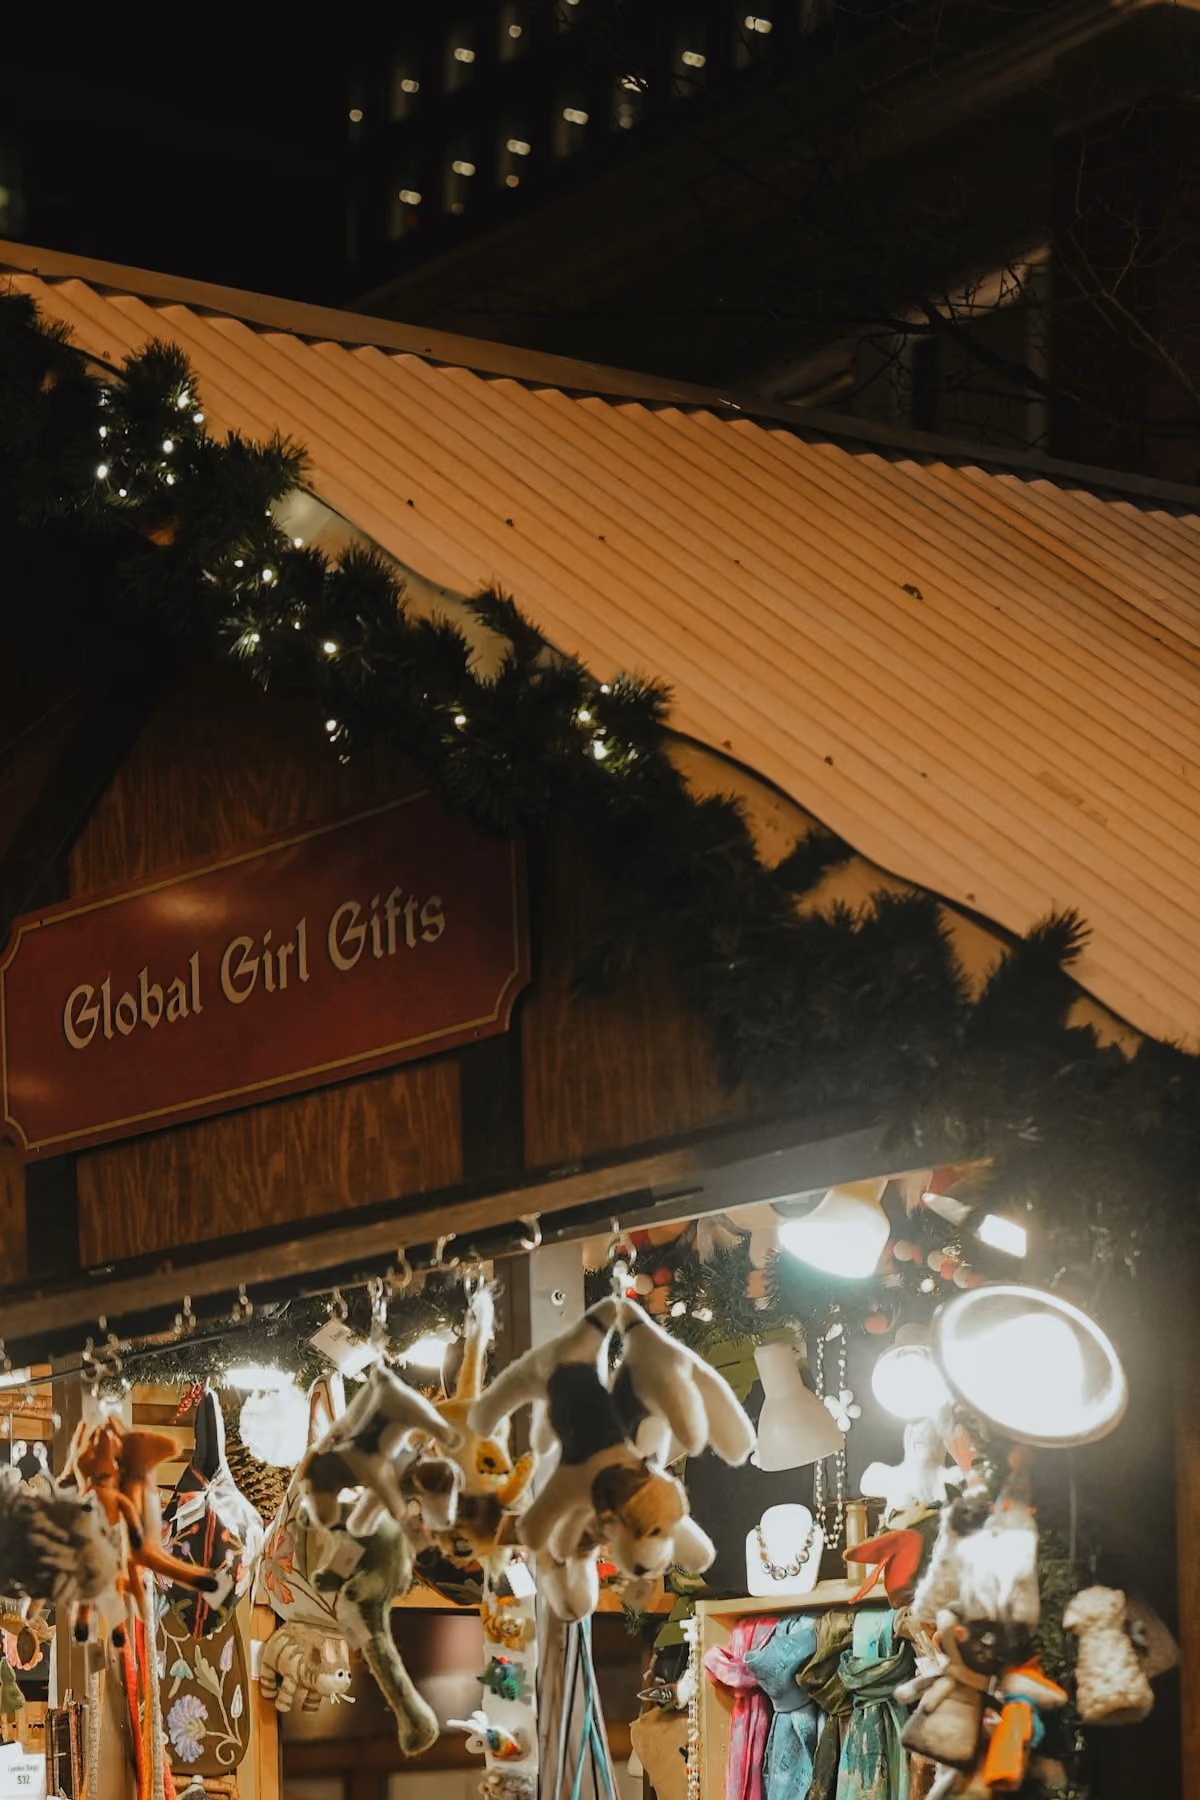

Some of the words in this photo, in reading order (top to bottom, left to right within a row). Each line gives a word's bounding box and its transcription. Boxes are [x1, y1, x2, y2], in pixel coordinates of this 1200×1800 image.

[63, 949, 204, 1049] Global
[221, 917, 310, 1004] Girl
[328, 885, 447, 971] Gifts
